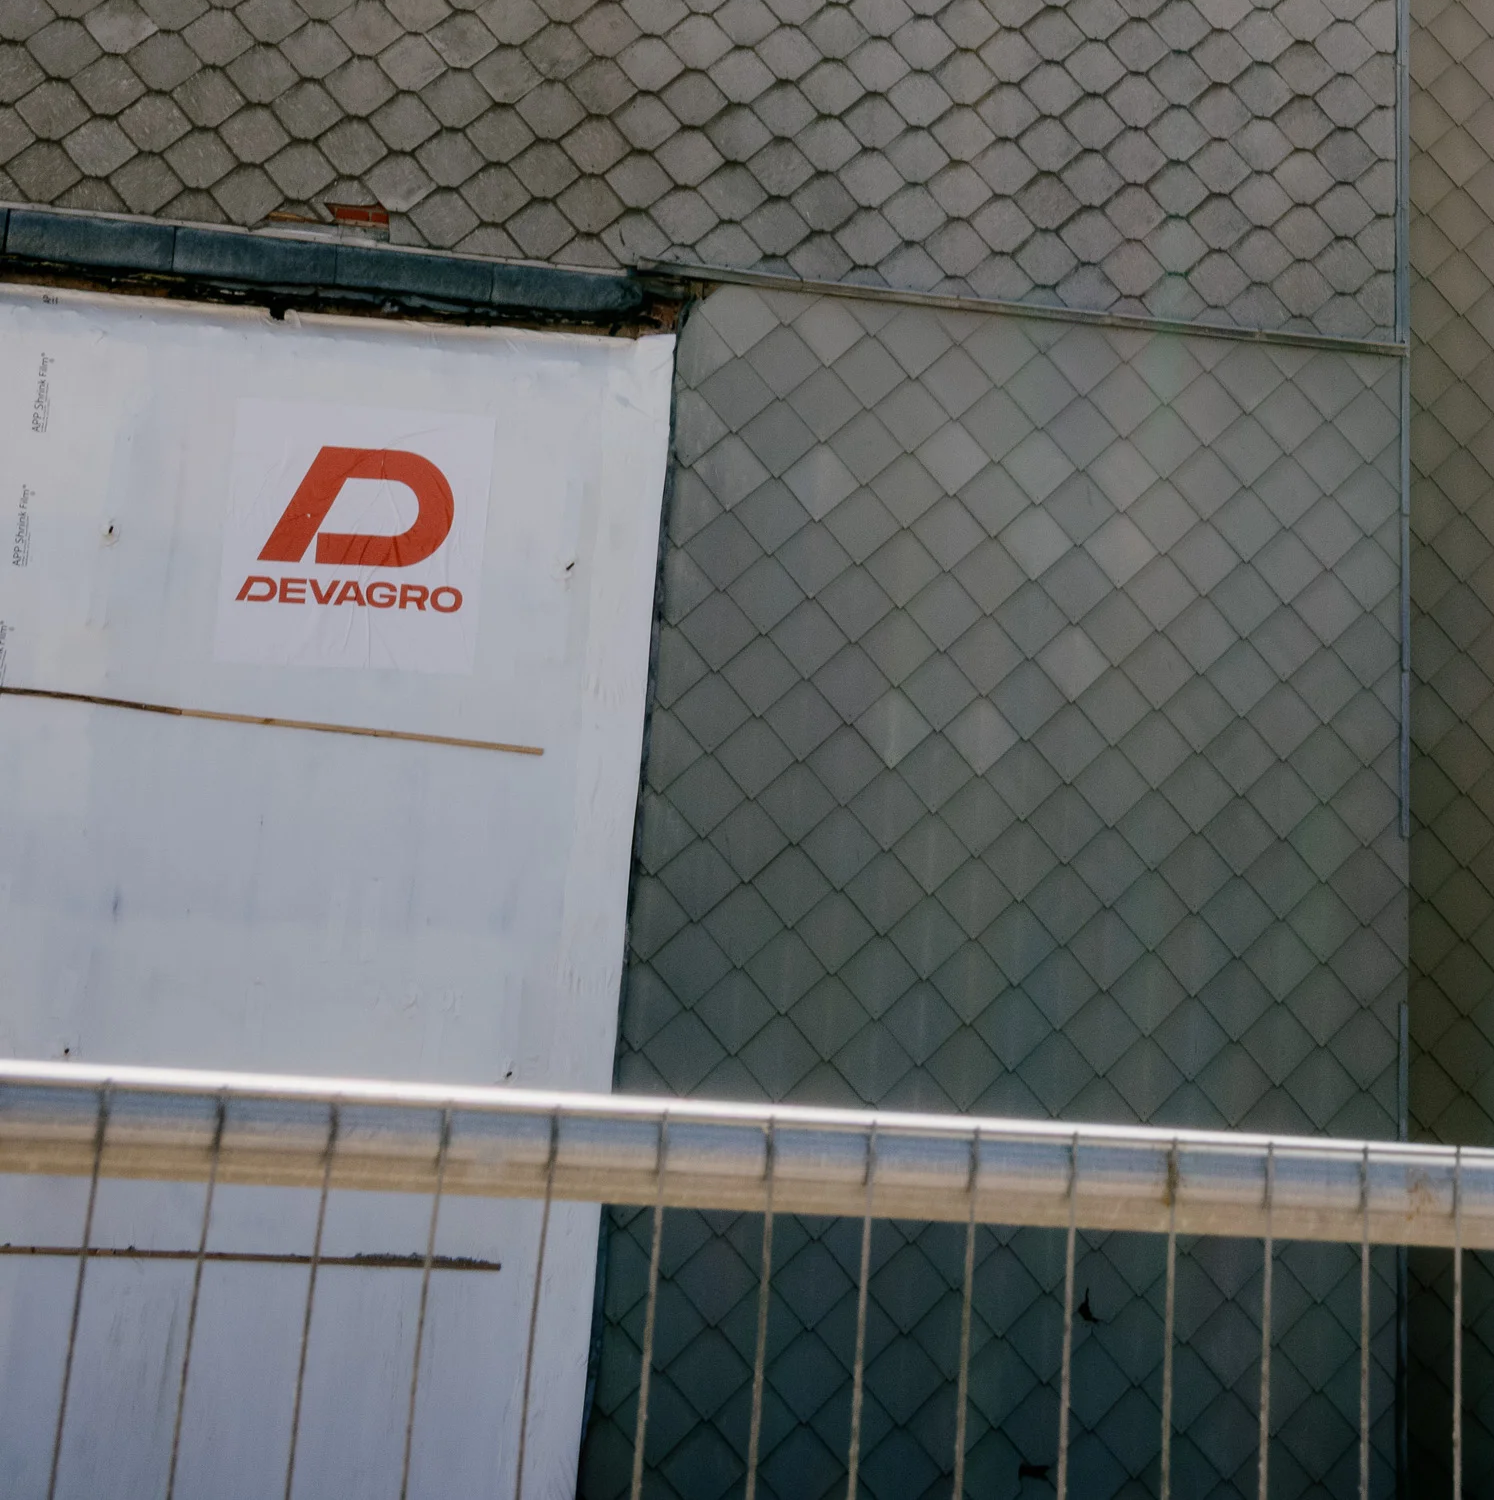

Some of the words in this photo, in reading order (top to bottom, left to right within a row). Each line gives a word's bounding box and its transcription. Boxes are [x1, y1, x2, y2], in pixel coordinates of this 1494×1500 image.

[34, 379, 46, 411] Shrink
[32, 411, 42, 433] APP
[15, 511, 26, 545] Shrink
[12, 545, 21, 567] APP
[235, 575, 463, 614] DEVAGRO
